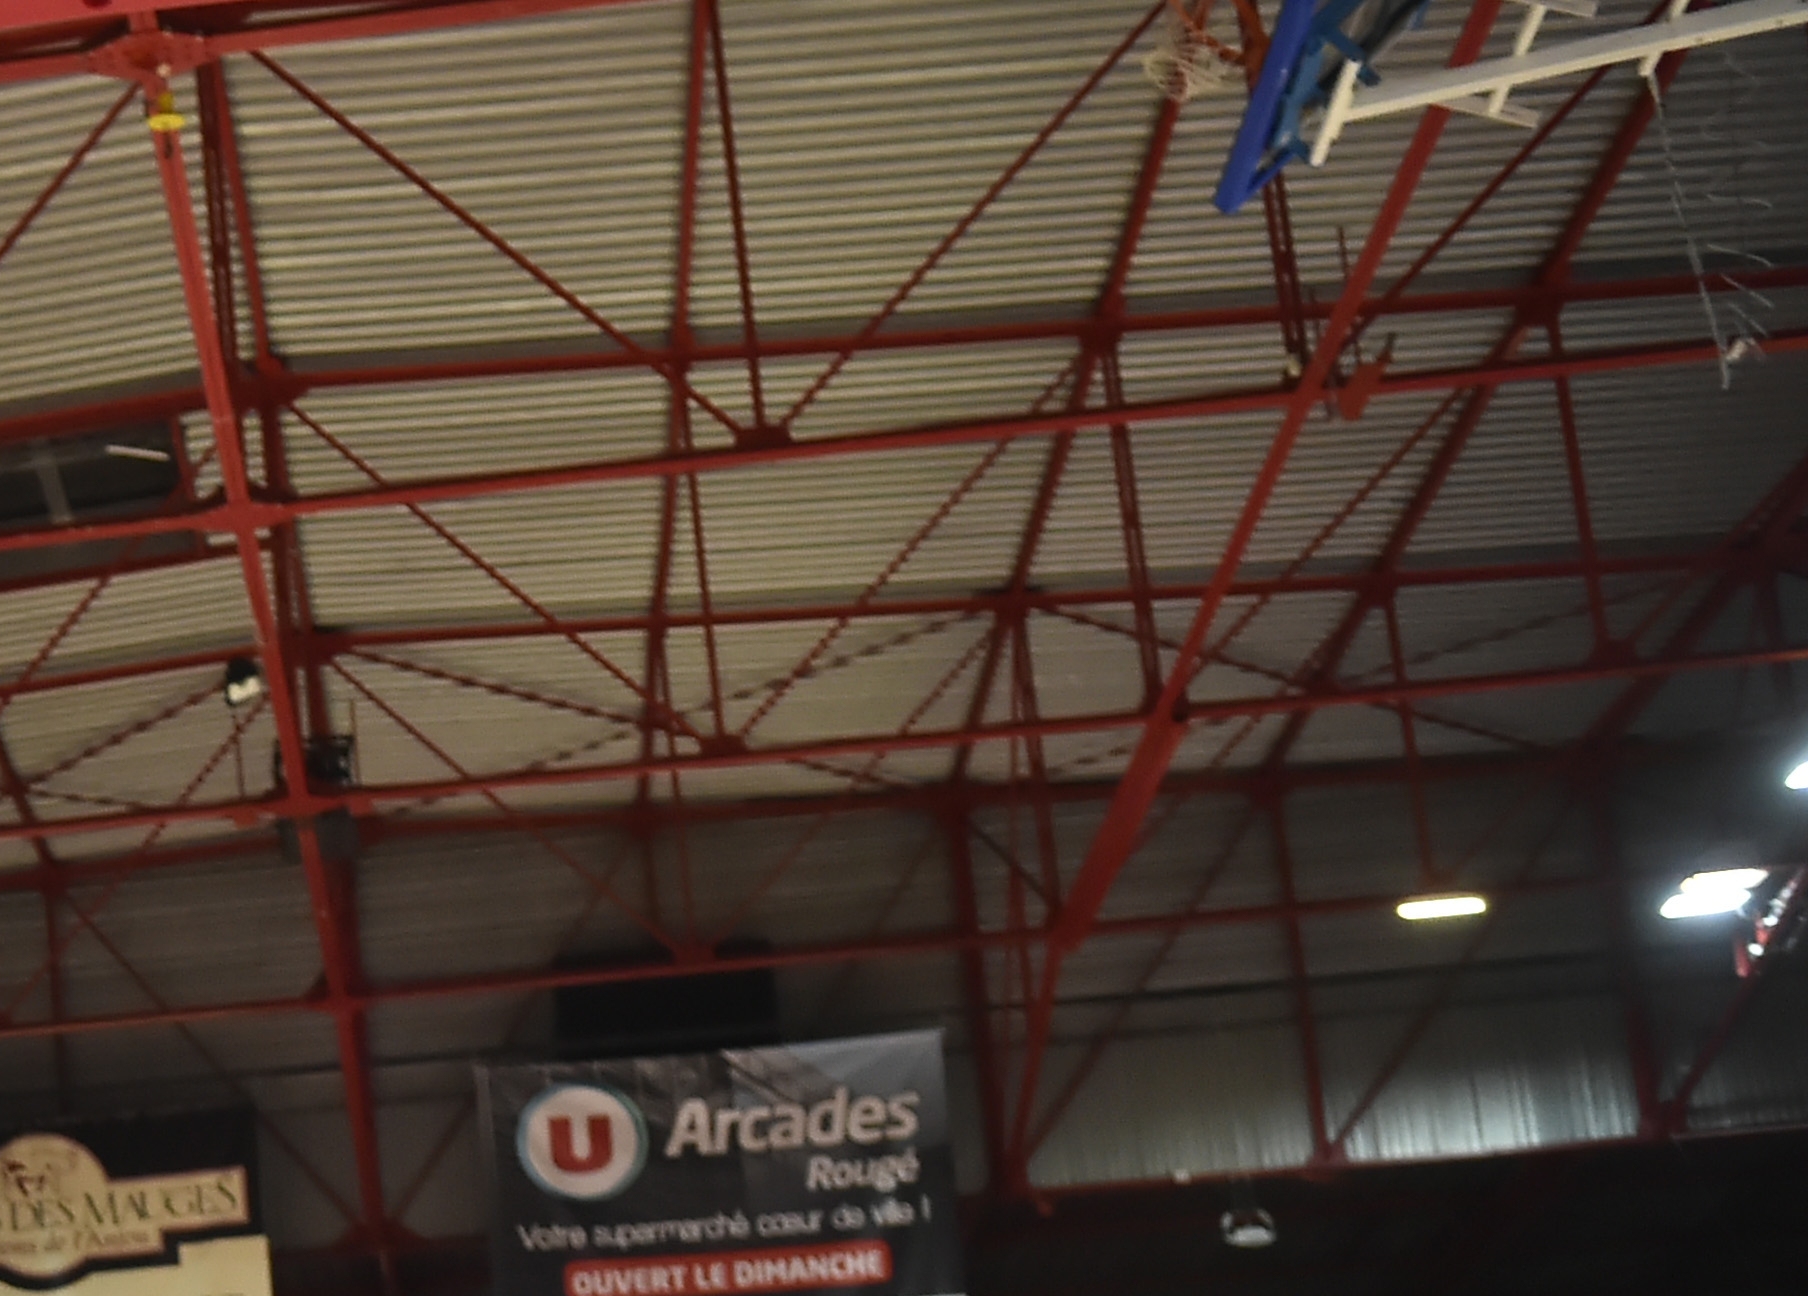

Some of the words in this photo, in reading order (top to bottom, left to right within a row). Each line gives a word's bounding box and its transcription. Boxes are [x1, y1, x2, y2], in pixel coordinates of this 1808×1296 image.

[664, 1087, 920, 1157] Arcades
[9, 1195, 76, 1234] DES
[83, 1177, 239, 1226] MAUGES
[694, 1262, 725, 1290] LE
[733, 1249, 885, 1289] DIMANCHE
